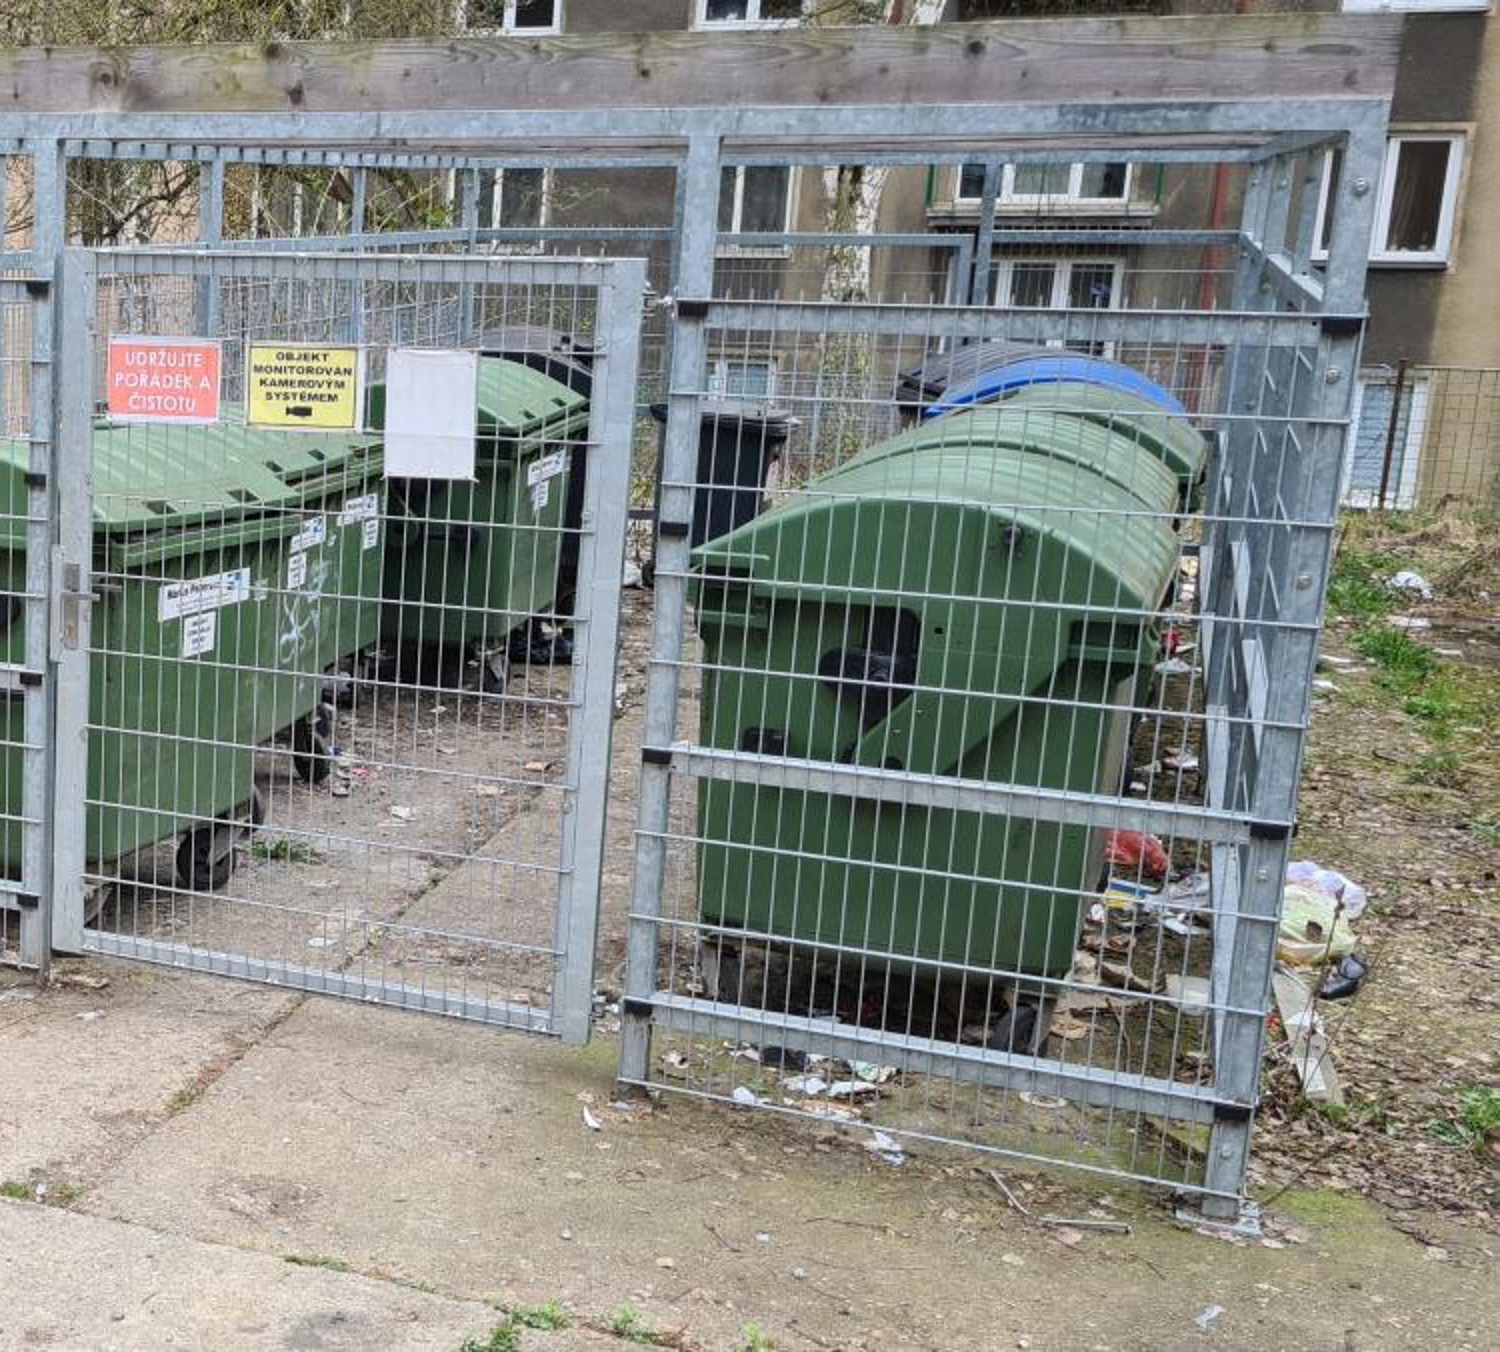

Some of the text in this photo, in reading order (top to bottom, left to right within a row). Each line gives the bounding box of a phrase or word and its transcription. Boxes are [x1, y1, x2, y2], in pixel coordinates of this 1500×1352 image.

[125, 349, 203, 368] UDRŽUJTE
[276, 352, 329, 362] OBJEKT
[200, 374, 211, 389] A
[260, 377, 345, 389] KAMEROVÝM
[129, 392, 196, 412] ČISTOTU
